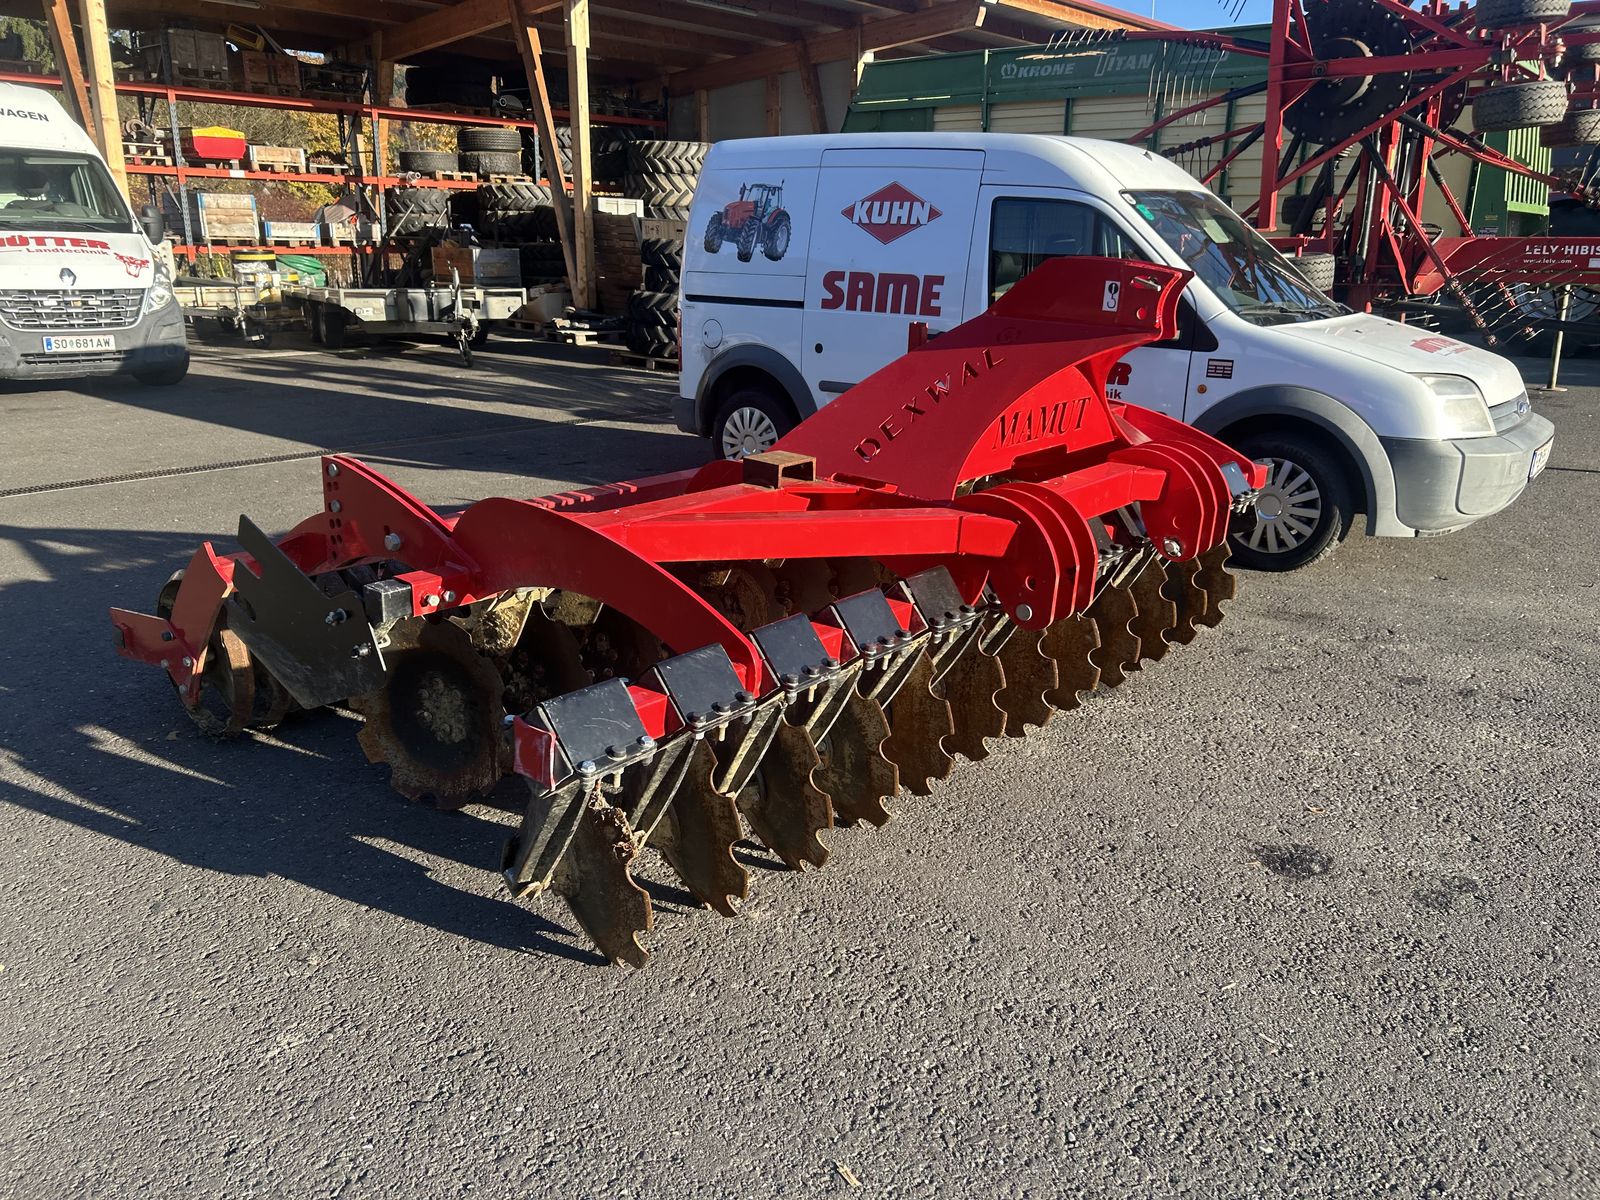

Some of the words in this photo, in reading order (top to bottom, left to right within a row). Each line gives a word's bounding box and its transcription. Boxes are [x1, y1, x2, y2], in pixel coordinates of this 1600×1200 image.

[1017, 62, 1076, 79] KRONE
[852, 200, 931, 225] KUHN
[26, 248, 109, 256] Landtechnik
[820, 270, 945, 317] SAME
[854, 348, 1006, 463] DEXWAL
[992, 396, 1091, 451] MAMUT
